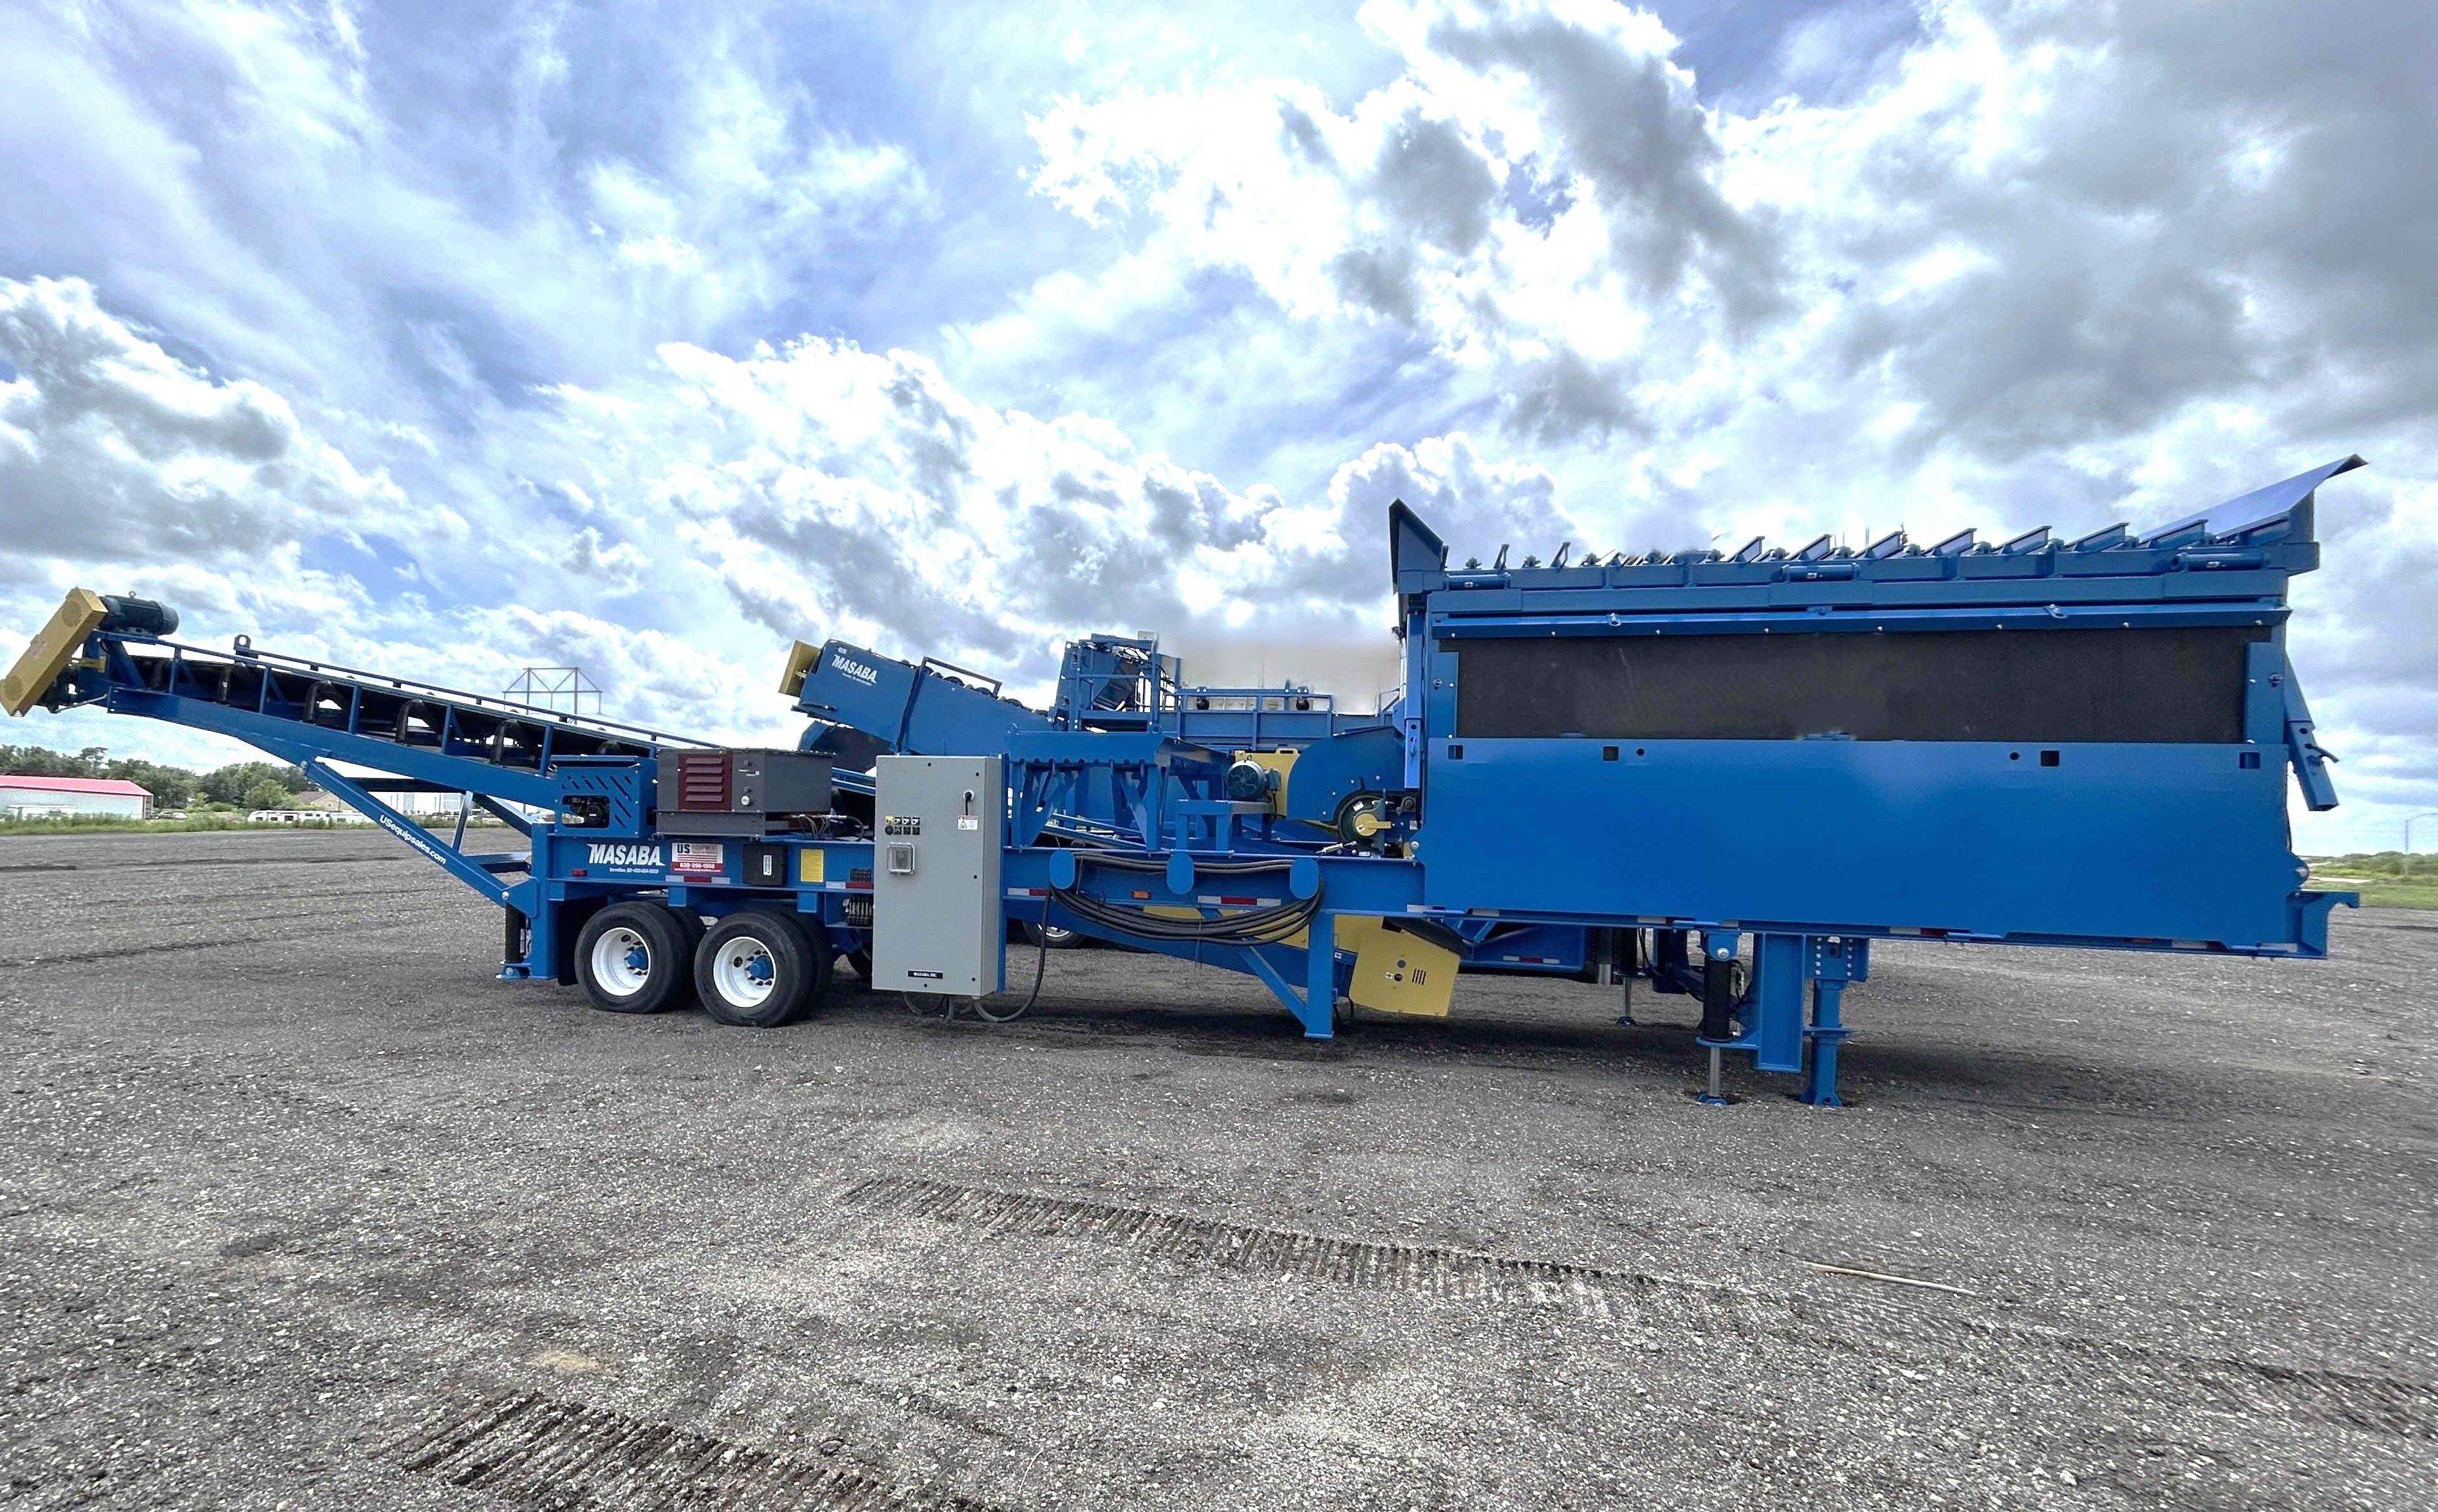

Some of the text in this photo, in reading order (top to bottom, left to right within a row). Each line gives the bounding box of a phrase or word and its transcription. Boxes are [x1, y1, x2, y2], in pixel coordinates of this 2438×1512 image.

[832, 654, 877, 683] MASABA
[380, 815, 447, 864] USequipsales.com
[677, 844, 690, 854] US
[586, 844, 665, 866] MASABA
